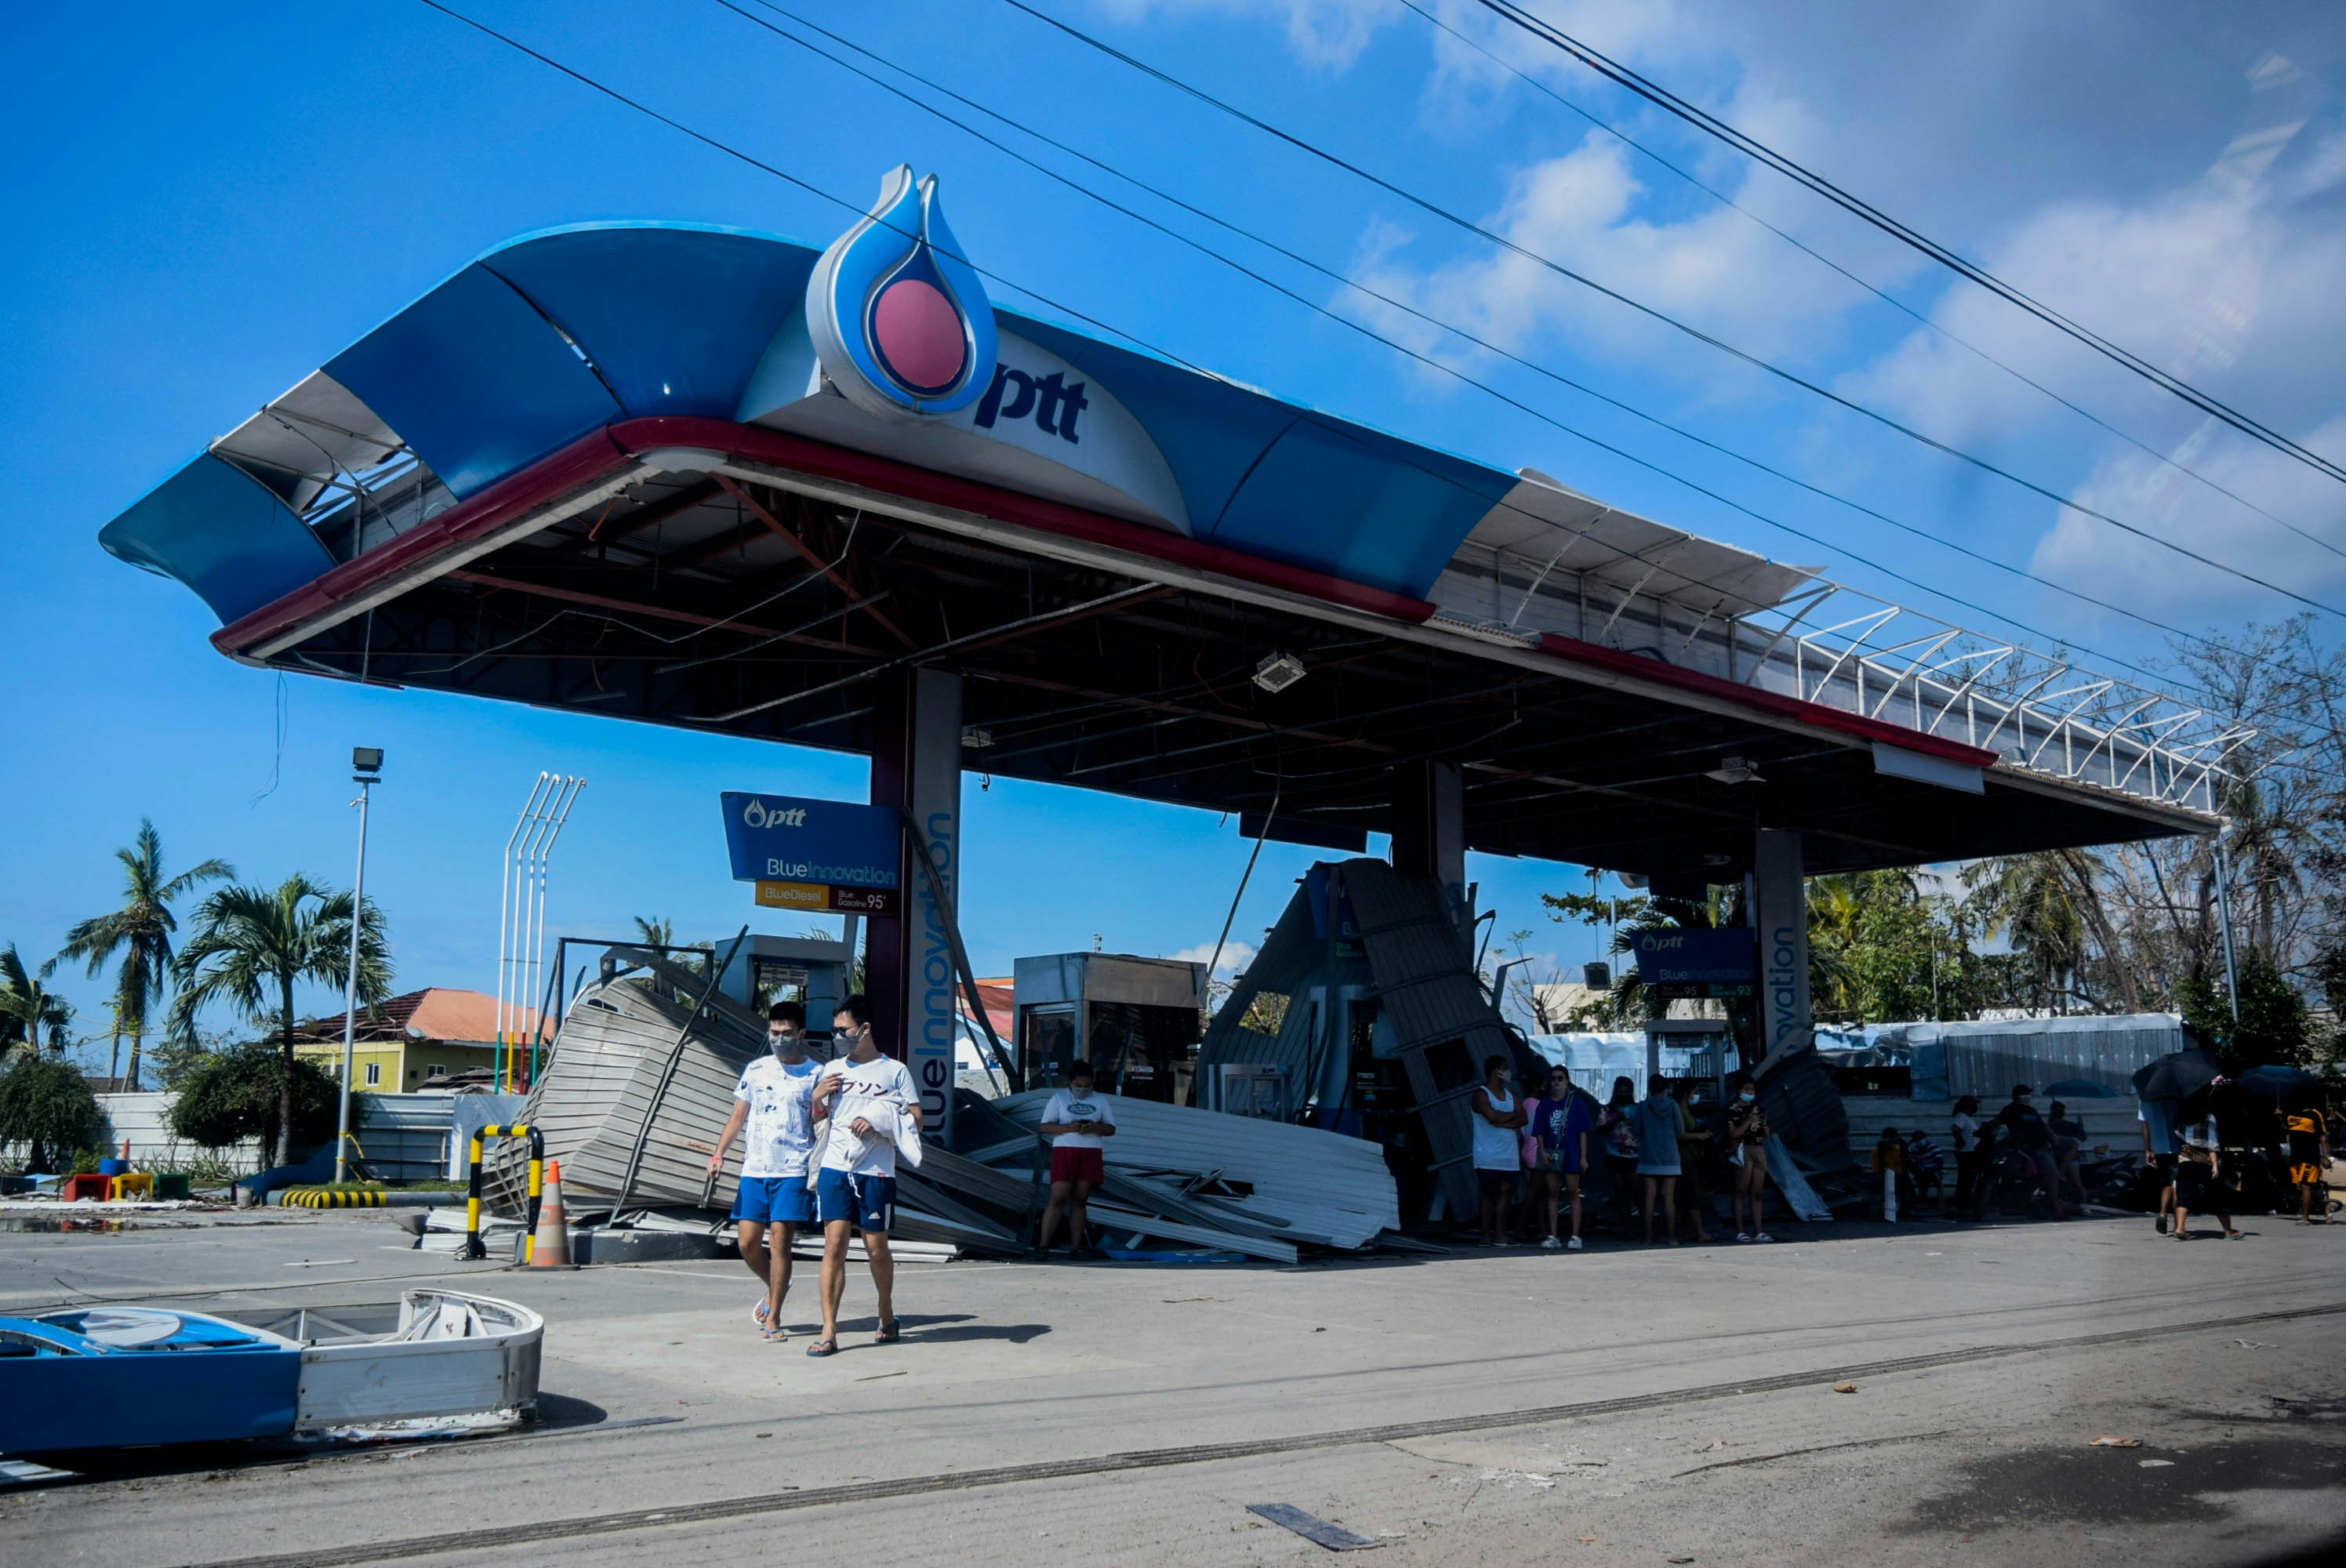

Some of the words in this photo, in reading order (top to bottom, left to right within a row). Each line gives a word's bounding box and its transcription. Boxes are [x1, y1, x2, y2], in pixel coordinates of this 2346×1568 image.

[974, 363, 1089, 445] ptt
[765, 808, 807, 829] ptt
[764, 887, 822, 902] BlueDiesel
[837, 890, 854, 899] Blue
[837, 897, 867, 909] Gasoline
[1656, 935, 1686, 951] ptt
